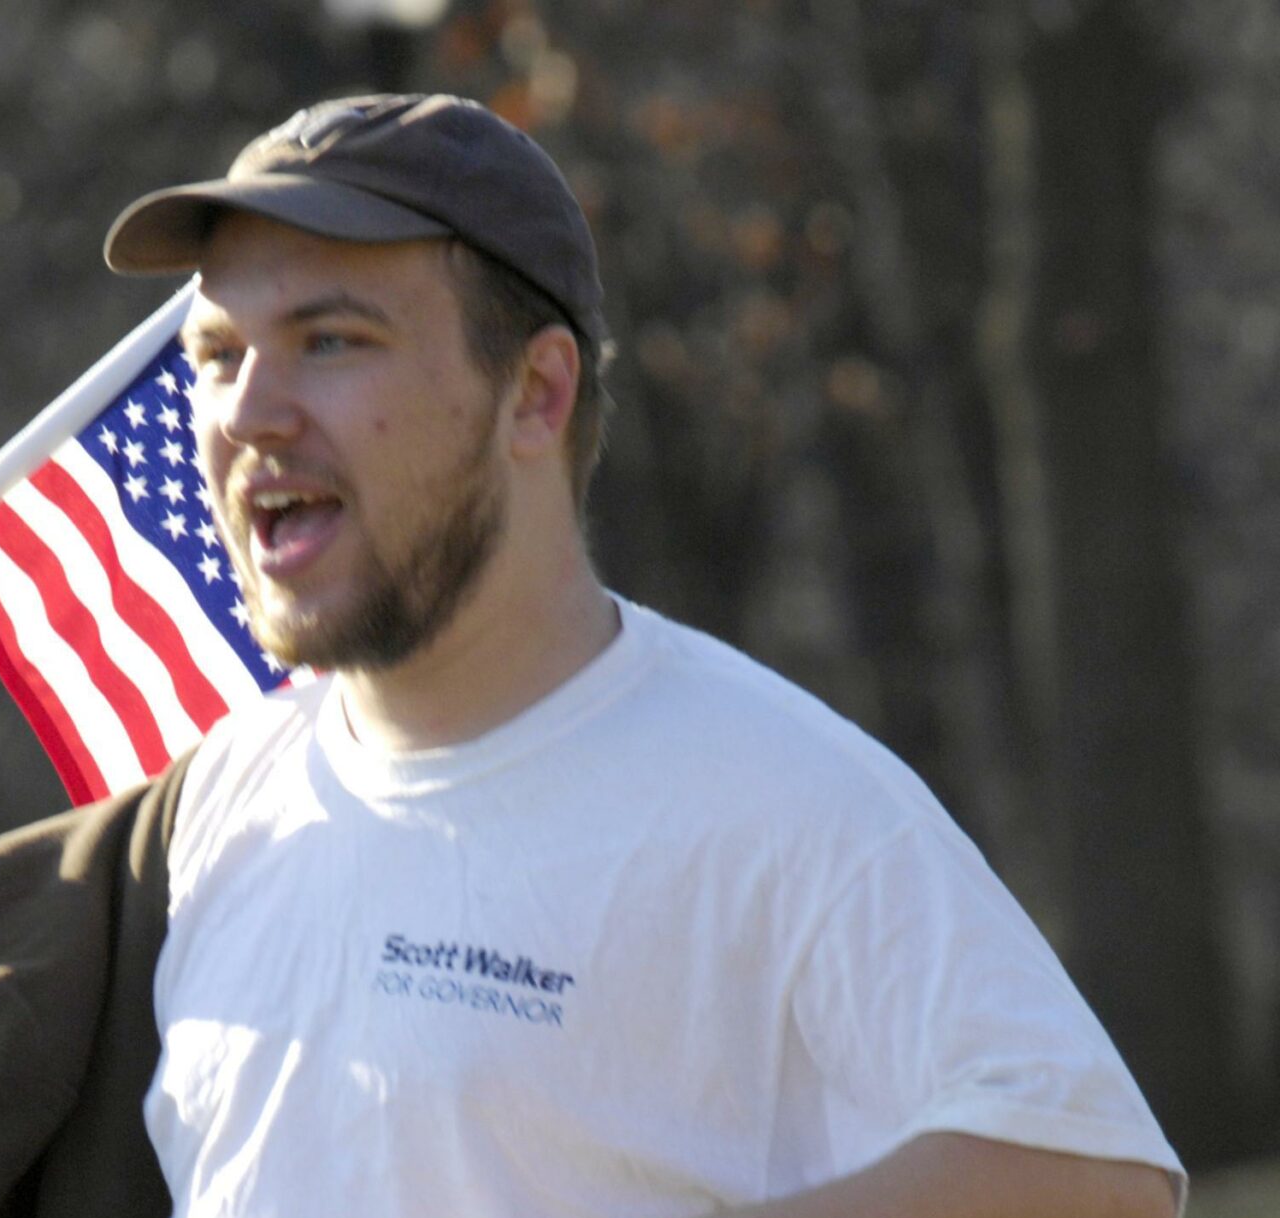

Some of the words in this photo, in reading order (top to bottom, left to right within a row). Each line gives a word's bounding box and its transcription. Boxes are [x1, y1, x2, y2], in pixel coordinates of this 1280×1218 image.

[382, 933, 459, 971] Scott
[464, 944, 576, 995] Walker
[418, 975, 564, 1028] GOVERNOR
